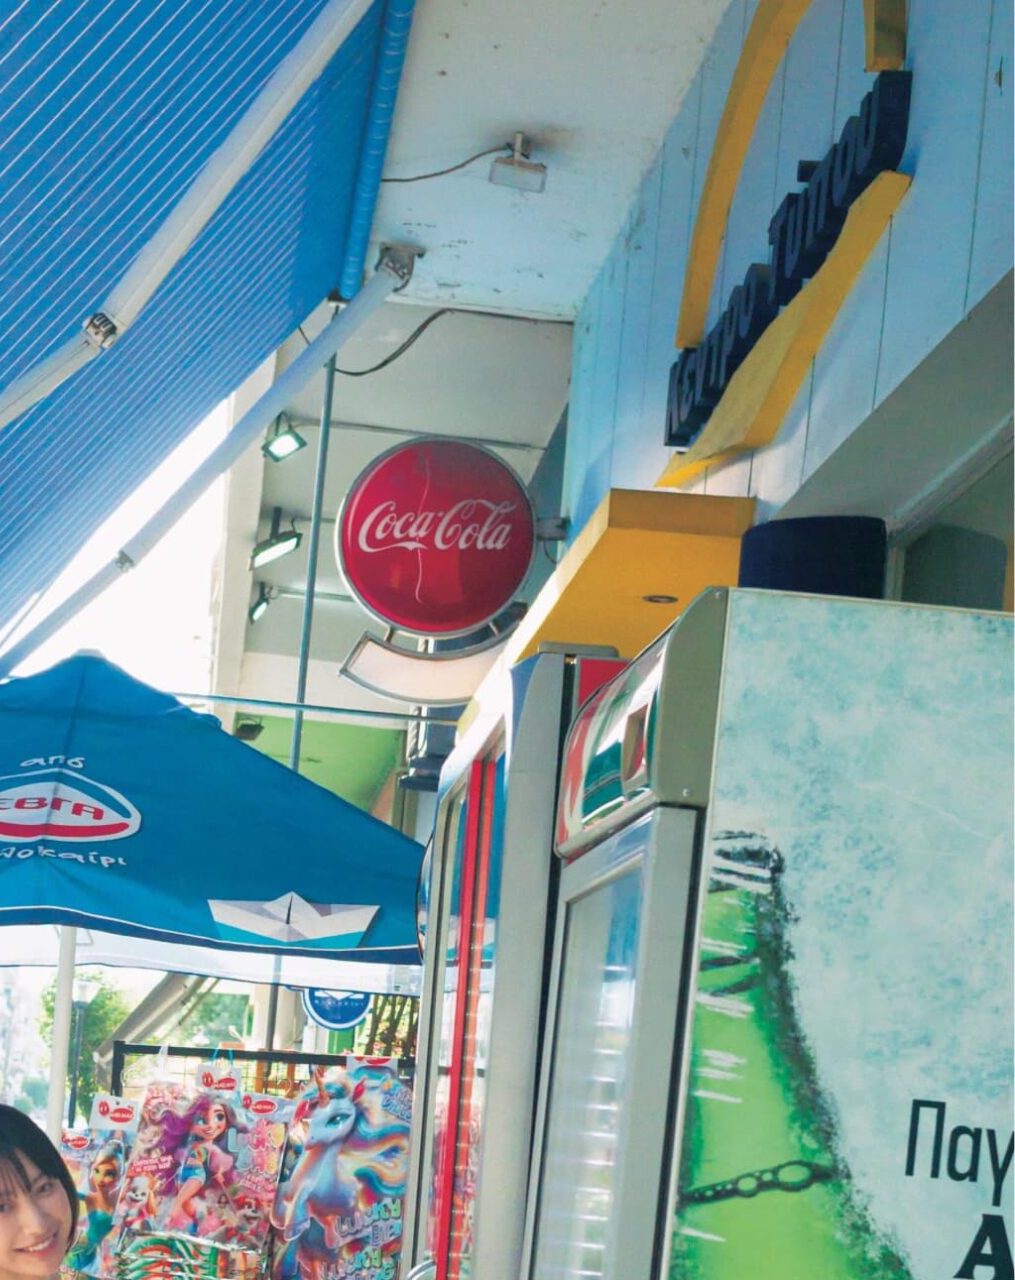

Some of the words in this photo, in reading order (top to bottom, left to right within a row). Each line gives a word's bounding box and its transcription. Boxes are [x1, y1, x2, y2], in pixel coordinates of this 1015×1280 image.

[358, 499, 517, 553] Coca-Cola
[20, 754, 86, 769] από
[904, 1098, 1015, 1208] Παγ
